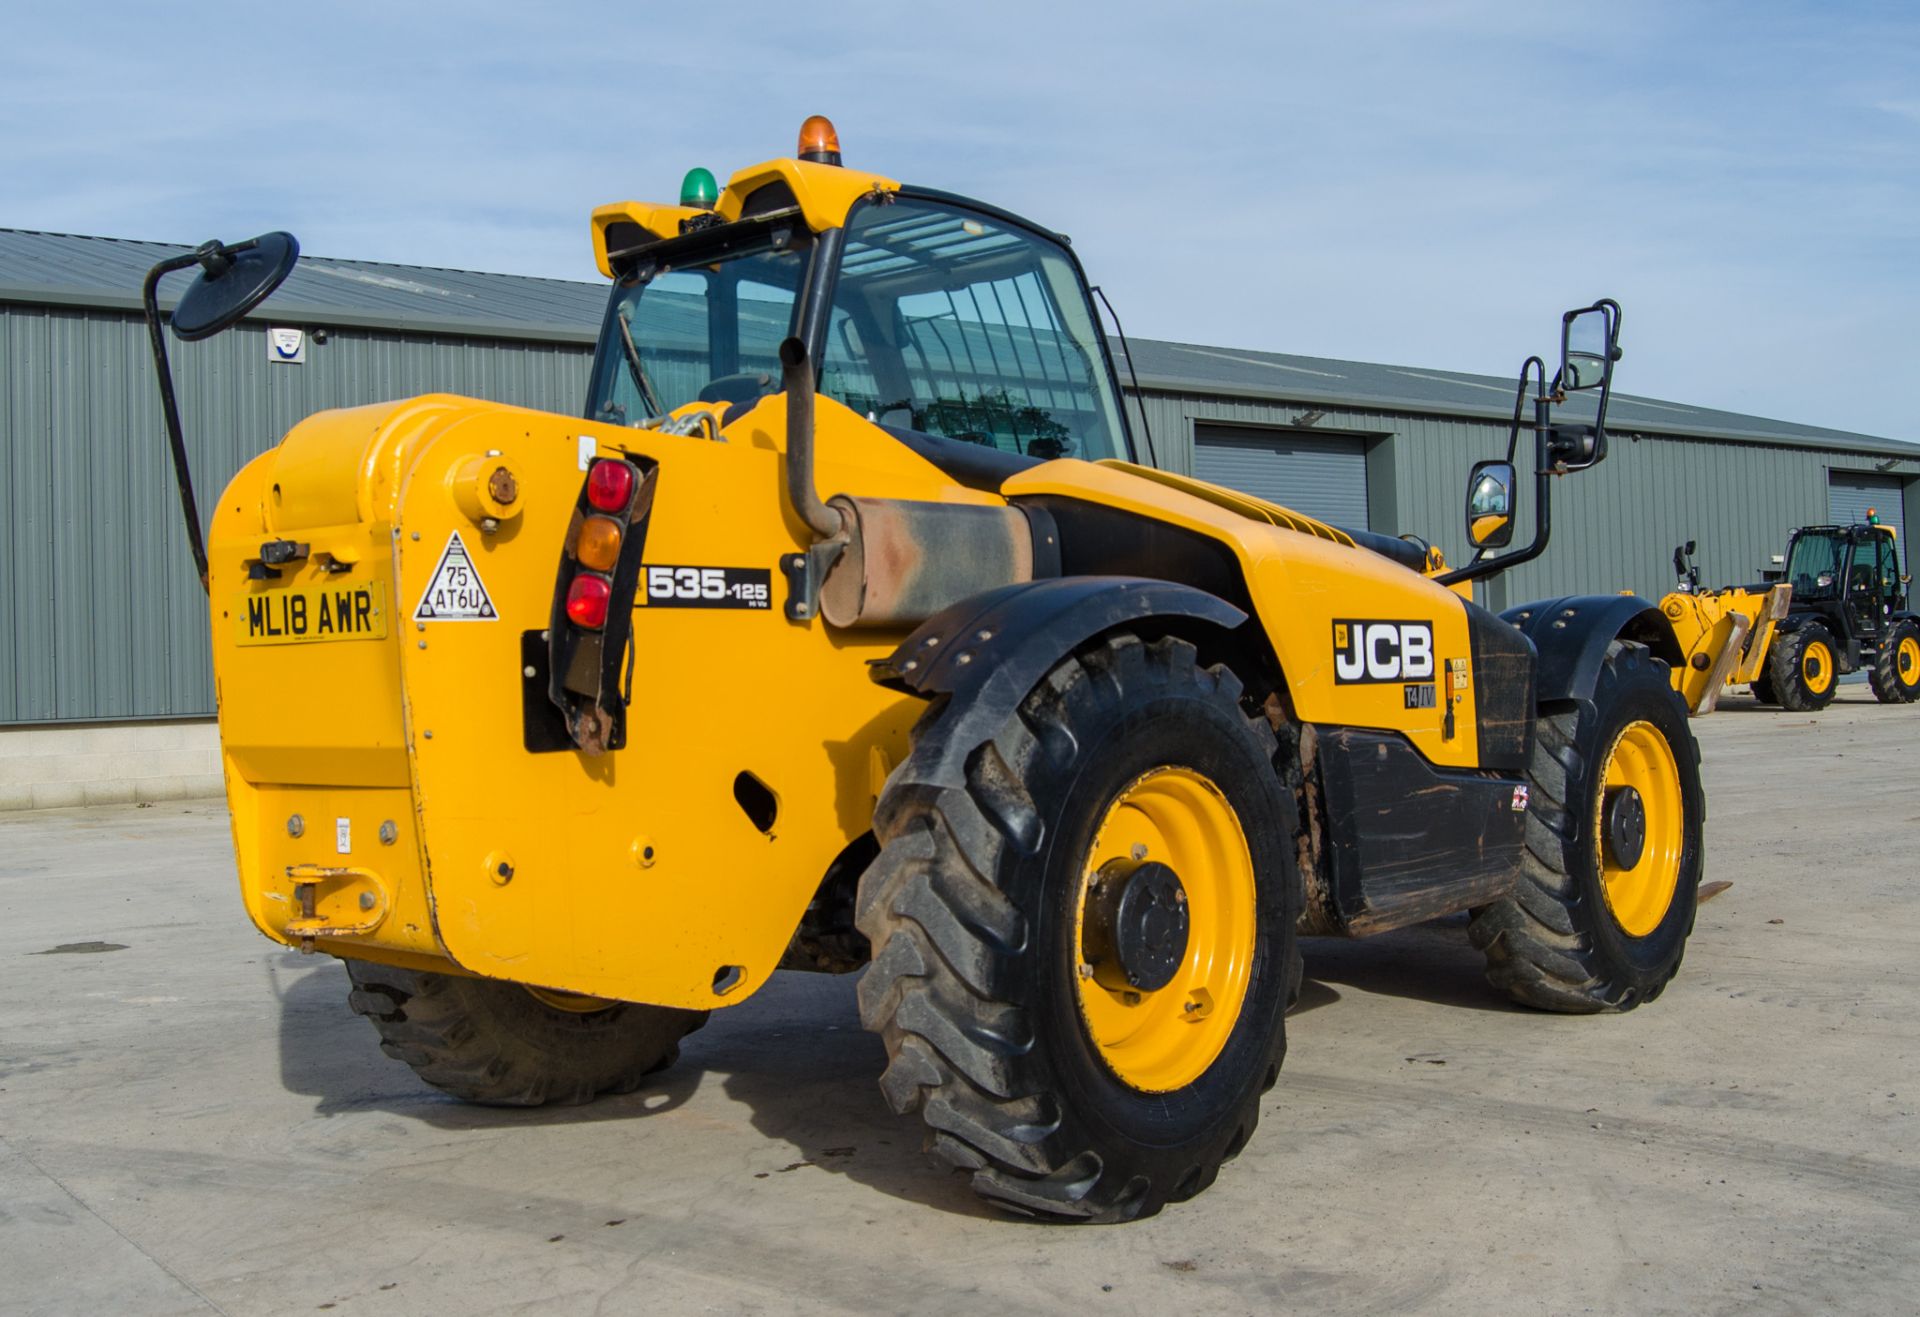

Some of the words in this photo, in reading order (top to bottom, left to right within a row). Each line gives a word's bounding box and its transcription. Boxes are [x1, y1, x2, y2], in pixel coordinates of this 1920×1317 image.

[446, 566, 468, 587] 75
[247, 594, 308, 637] ML18
[318, 590, 372, 635] AWR
[435, 588, 480, 609] AT6U
[1336, 623, 1434, 680] JCB
